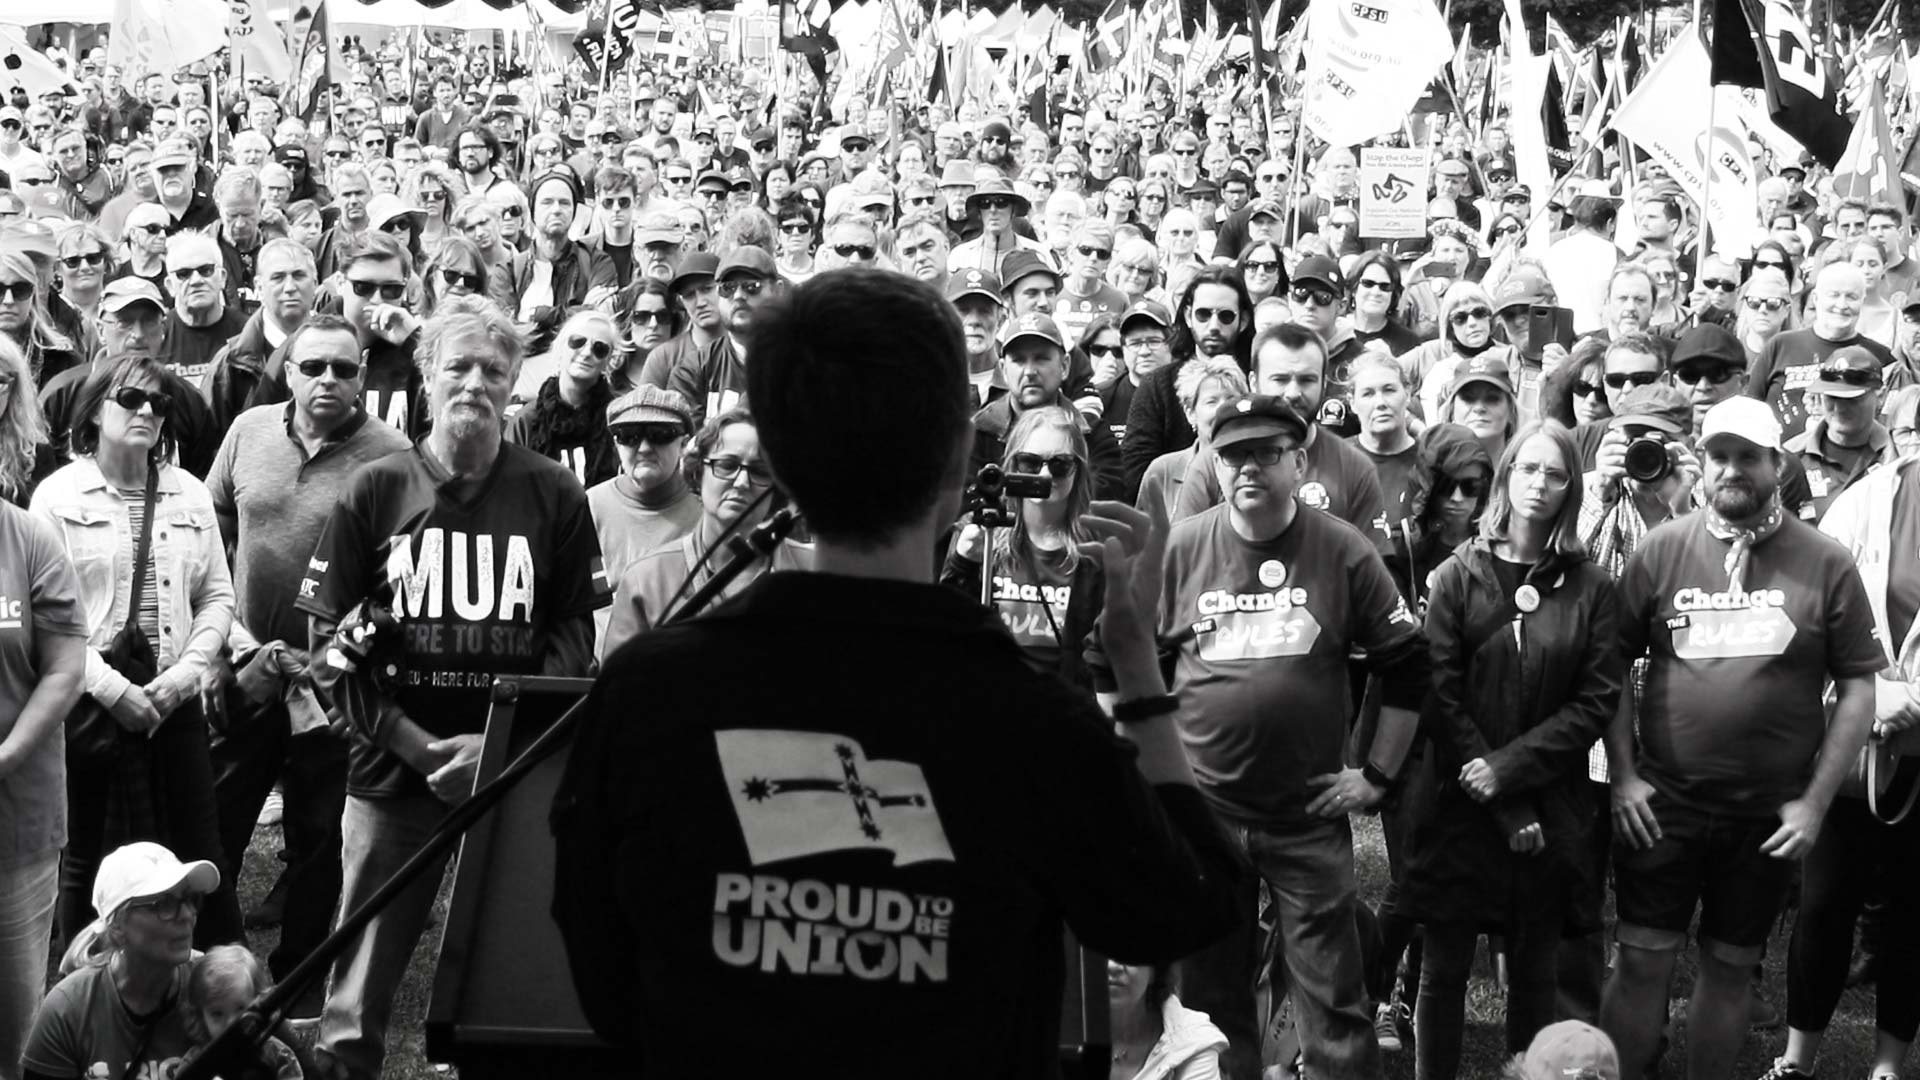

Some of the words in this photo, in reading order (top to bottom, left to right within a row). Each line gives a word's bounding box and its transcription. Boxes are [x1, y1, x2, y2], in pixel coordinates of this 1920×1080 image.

[1351, 3, 1388, 23] CPSU
[1326, 69, 1356, 98] CPSU
[387, 528, 534, 622] MUA
[0, 596, 22, 620] ic
[992, 576, 1072, 611] Chang
[1197, 586, 1308, 615] Change
[1673, 587, 1785, 614] Change
[405, 623, 444, 653] ERE
[452, 623, 483, 655] TO
[490, 625, 534, 656] STAY
[1216, 618, 1305, 648] RULES
[1688, 619, 1781, 647] RULES
[432, 671, 463, 687] HERE
[713, 872, 914, 932] PROUD
[914, 894, 954, 917] TO
[914, 915, 952, 938] BE
[711, 913, 949, 984] UNION
